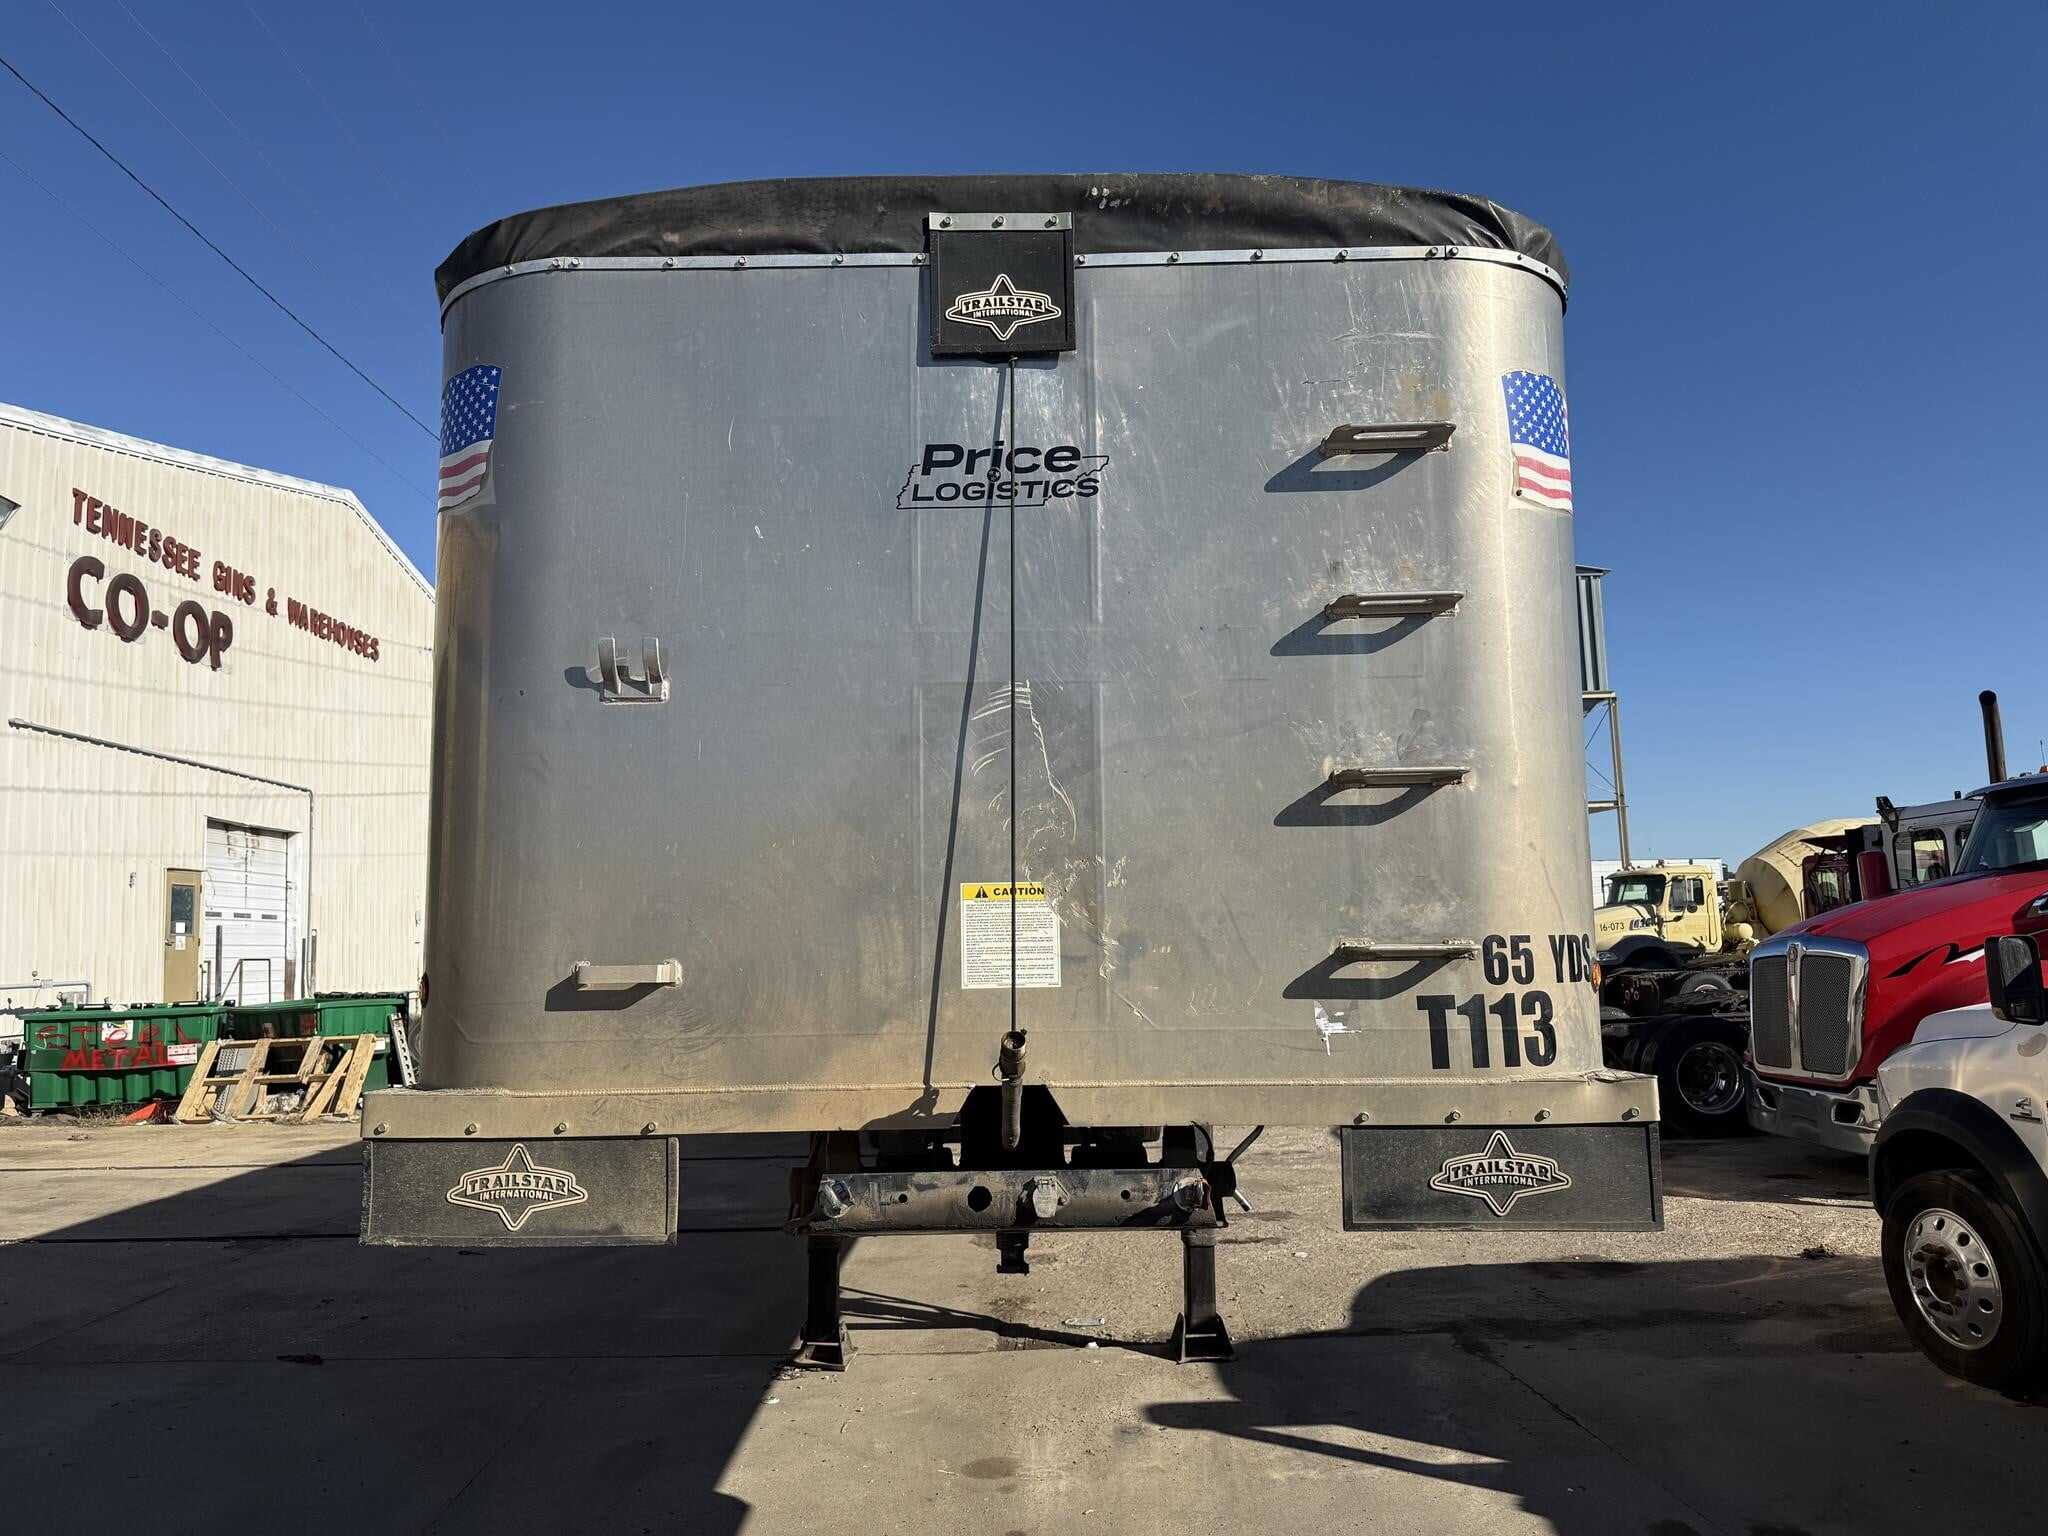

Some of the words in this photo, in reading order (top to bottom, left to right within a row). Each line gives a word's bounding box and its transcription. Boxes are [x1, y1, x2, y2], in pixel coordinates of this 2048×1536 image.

[962, 297, 1045, 312] TRAILSTAR
[973, 309, 1034, 318] INTERNATIONAL
[921, 441, 1081, 476] Price
[912, 478, 1099, 501] LOGISTICS
[72, 488, 202, 582] TENNESSEE
[212, 560, 257, 606] GINS
[265, 587, 279, 617] &
[287, 597, 380, 663] WAREHOUSES
[67, 556, 234, 672] CO-OP
[993, 887, 1045, 896] CAUTION
[1482, 934, 1535, 985] 65
[1548, 933, 1592, 984] YDS
[1416, 990, 1557, 1070] T113
[60, 1041, 176, 1071] METAL
[1451, 1161, 1550, 1180] TRAILSTAR
[1463, 1175, 1538, 1187] INTERNATIONAL
[468, 1174, 567, 1194] TRAILSTAR
[479, 1189, 554, 1201] INTERNATIONAL
